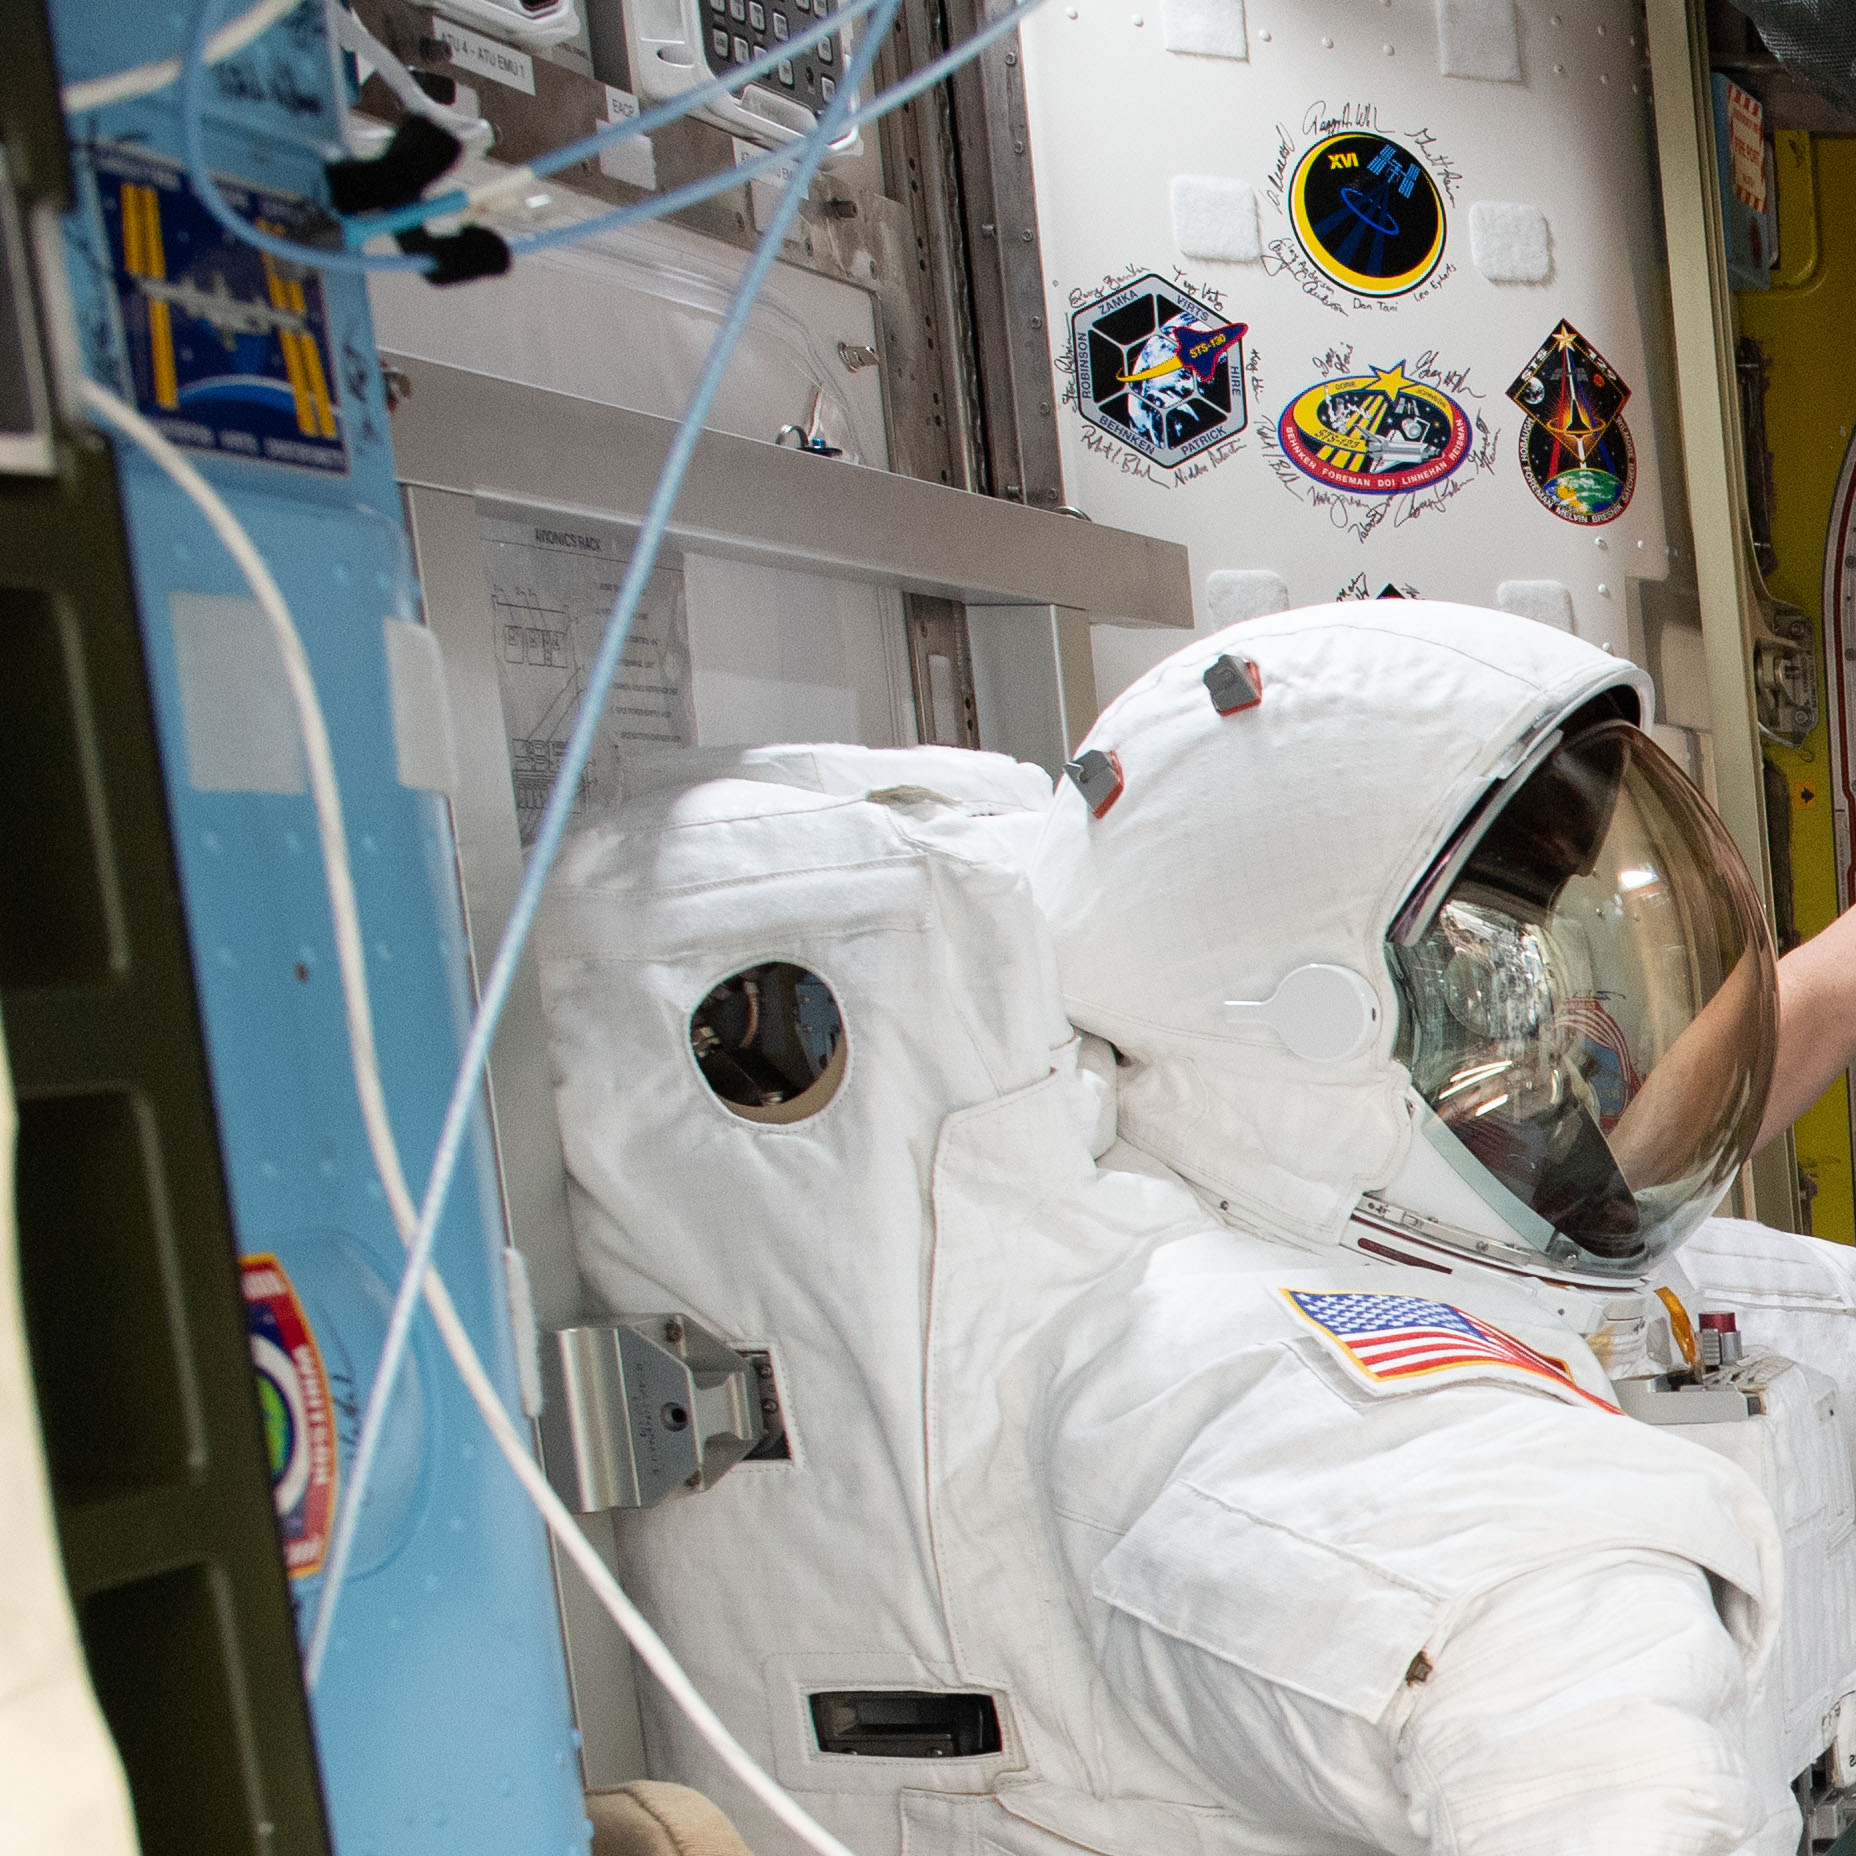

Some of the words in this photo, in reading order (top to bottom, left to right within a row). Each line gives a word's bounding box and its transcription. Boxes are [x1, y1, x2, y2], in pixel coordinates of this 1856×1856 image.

[1327, 151, 1360, 170] XVI
[1098, 289, 1138, 315] ZAMKA
[1176, 295, 1209, 322] VIRTS
[1189, 333, 1227, 359] STS-130
[1077, 332, 1092, 399] ROBINSON
[1521, 347, 1550, 382] STS
[1230, 365, 1241, 397] HIRE
[1099, 415, 1156, 455] BEHNKEN
[1180, 425, 1228, 456] PATRICK
[1285, 426, 1318, 469] BEHNKEN
[1321, 467, 1371, 487] FOREMAN
[1378, 478, 1395, 488] DOI
[1401, 461, 1448, 486] LINNEHAN
[1450, 418, 1467, 462] REISMAN
[578, 535, 601, 552] RACK
